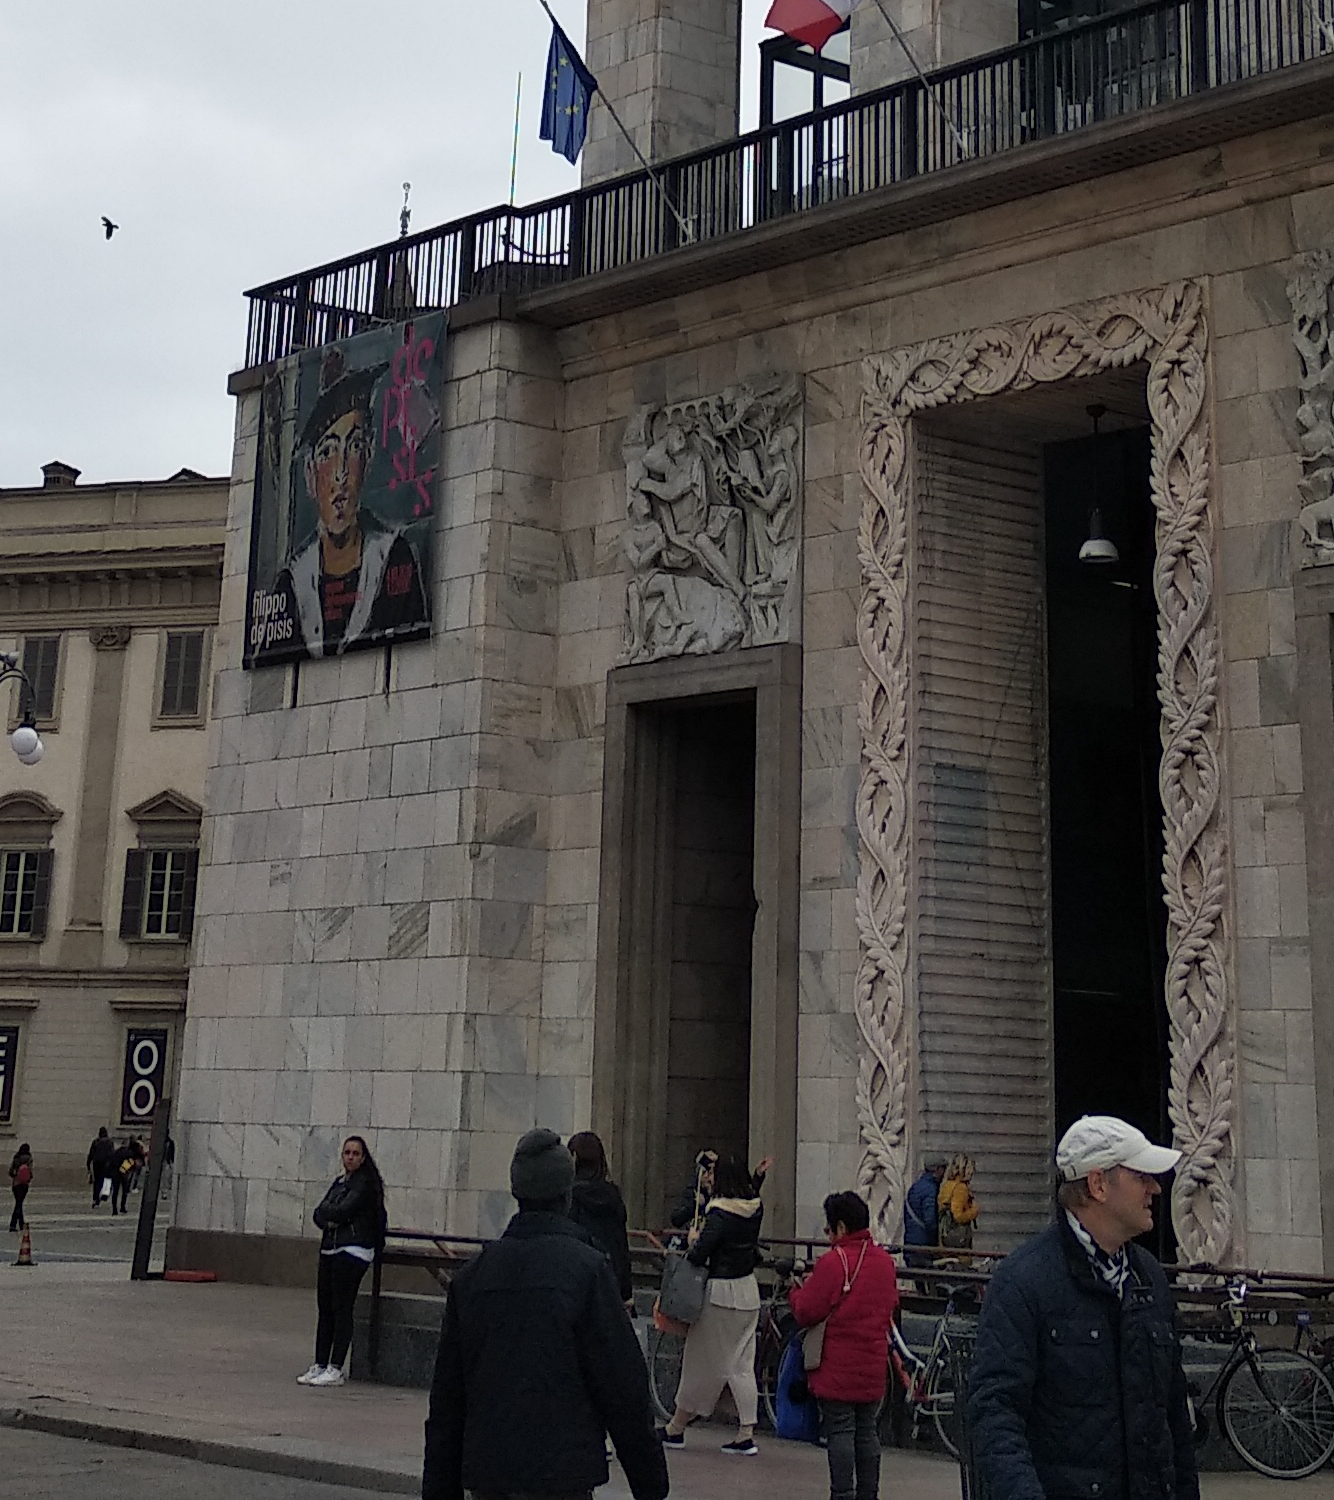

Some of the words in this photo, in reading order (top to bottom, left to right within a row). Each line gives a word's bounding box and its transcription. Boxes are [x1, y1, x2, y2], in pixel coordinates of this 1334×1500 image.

[252, 588, 287, 621] filippo
[250, 617, 264, 646] de
[265, 612, 294, 649] pisis
